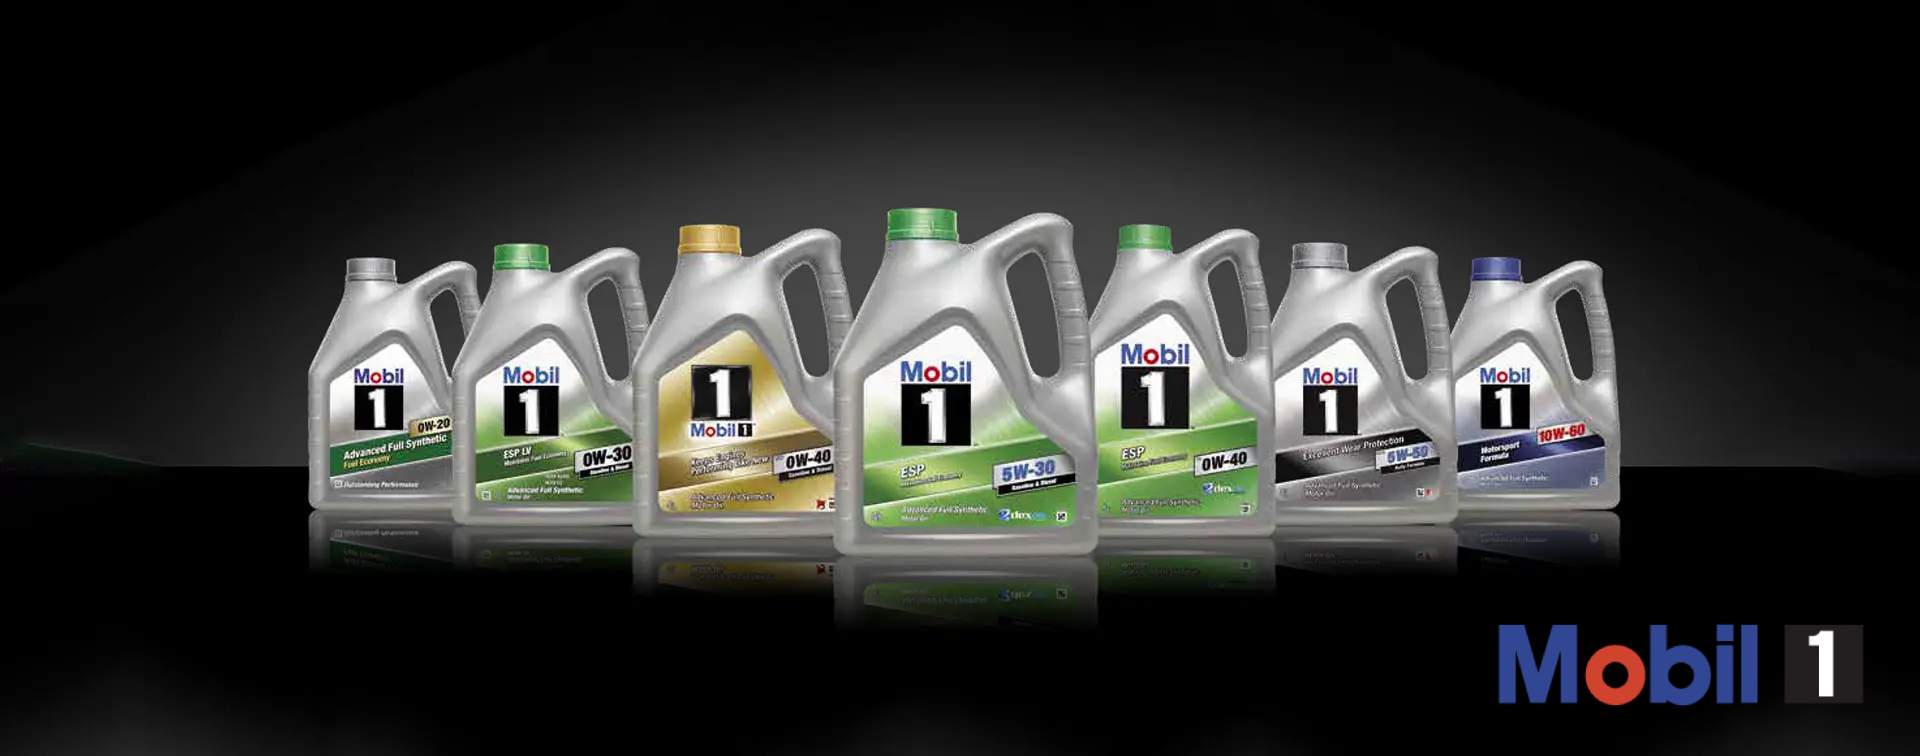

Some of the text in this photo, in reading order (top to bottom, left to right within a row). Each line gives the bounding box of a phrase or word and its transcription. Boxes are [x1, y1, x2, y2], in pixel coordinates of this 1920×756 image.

[1121, 344, 1189, 364] Mobil
[355, 368, 403, 384] Mobil
[504, 366, 559, 383] Mobil
[901, 361, 971, 382] Mobil
[1303, 368, 1357, 385] Mobil
[1481, 368, 1530, 383] Mobil
[710, 369, 731, 418] 1
[1140, 371, 1165, 426] 1
[368, 388, 386, 428] 1
[519, 389, 540, 434] 1
[921, 388, 946, 443] 1
[1319, 389, 1338, 433] 1
[1495, 388, 1512, 427] 1
[418, 418, 450, 433] 0W-20
[691, 423, 735, 437] Mobil
[1539, 424, 1585, 442] 10W-60
[344, 434, 447, 460] Advanced Full Synthetic
[504, 446, 532, 458] ESP LV
[1364, 437, 1404, 449] Protection
[1481, 442, 1520, 454] Motorsport
[360, 455, 390, 466] Economy
[583, 446, 631, 467] 0W-30
[786, 450, 830, 469] 0W-40
[1122, 447, 1144, 458] ESP
[1202, 452, 1247, 470] 0W-40
[1480, 453, 1509, 463] Formula
[901, 464, 925, 479] ESP
[1002, 460, 1055, 482] 5W-30
